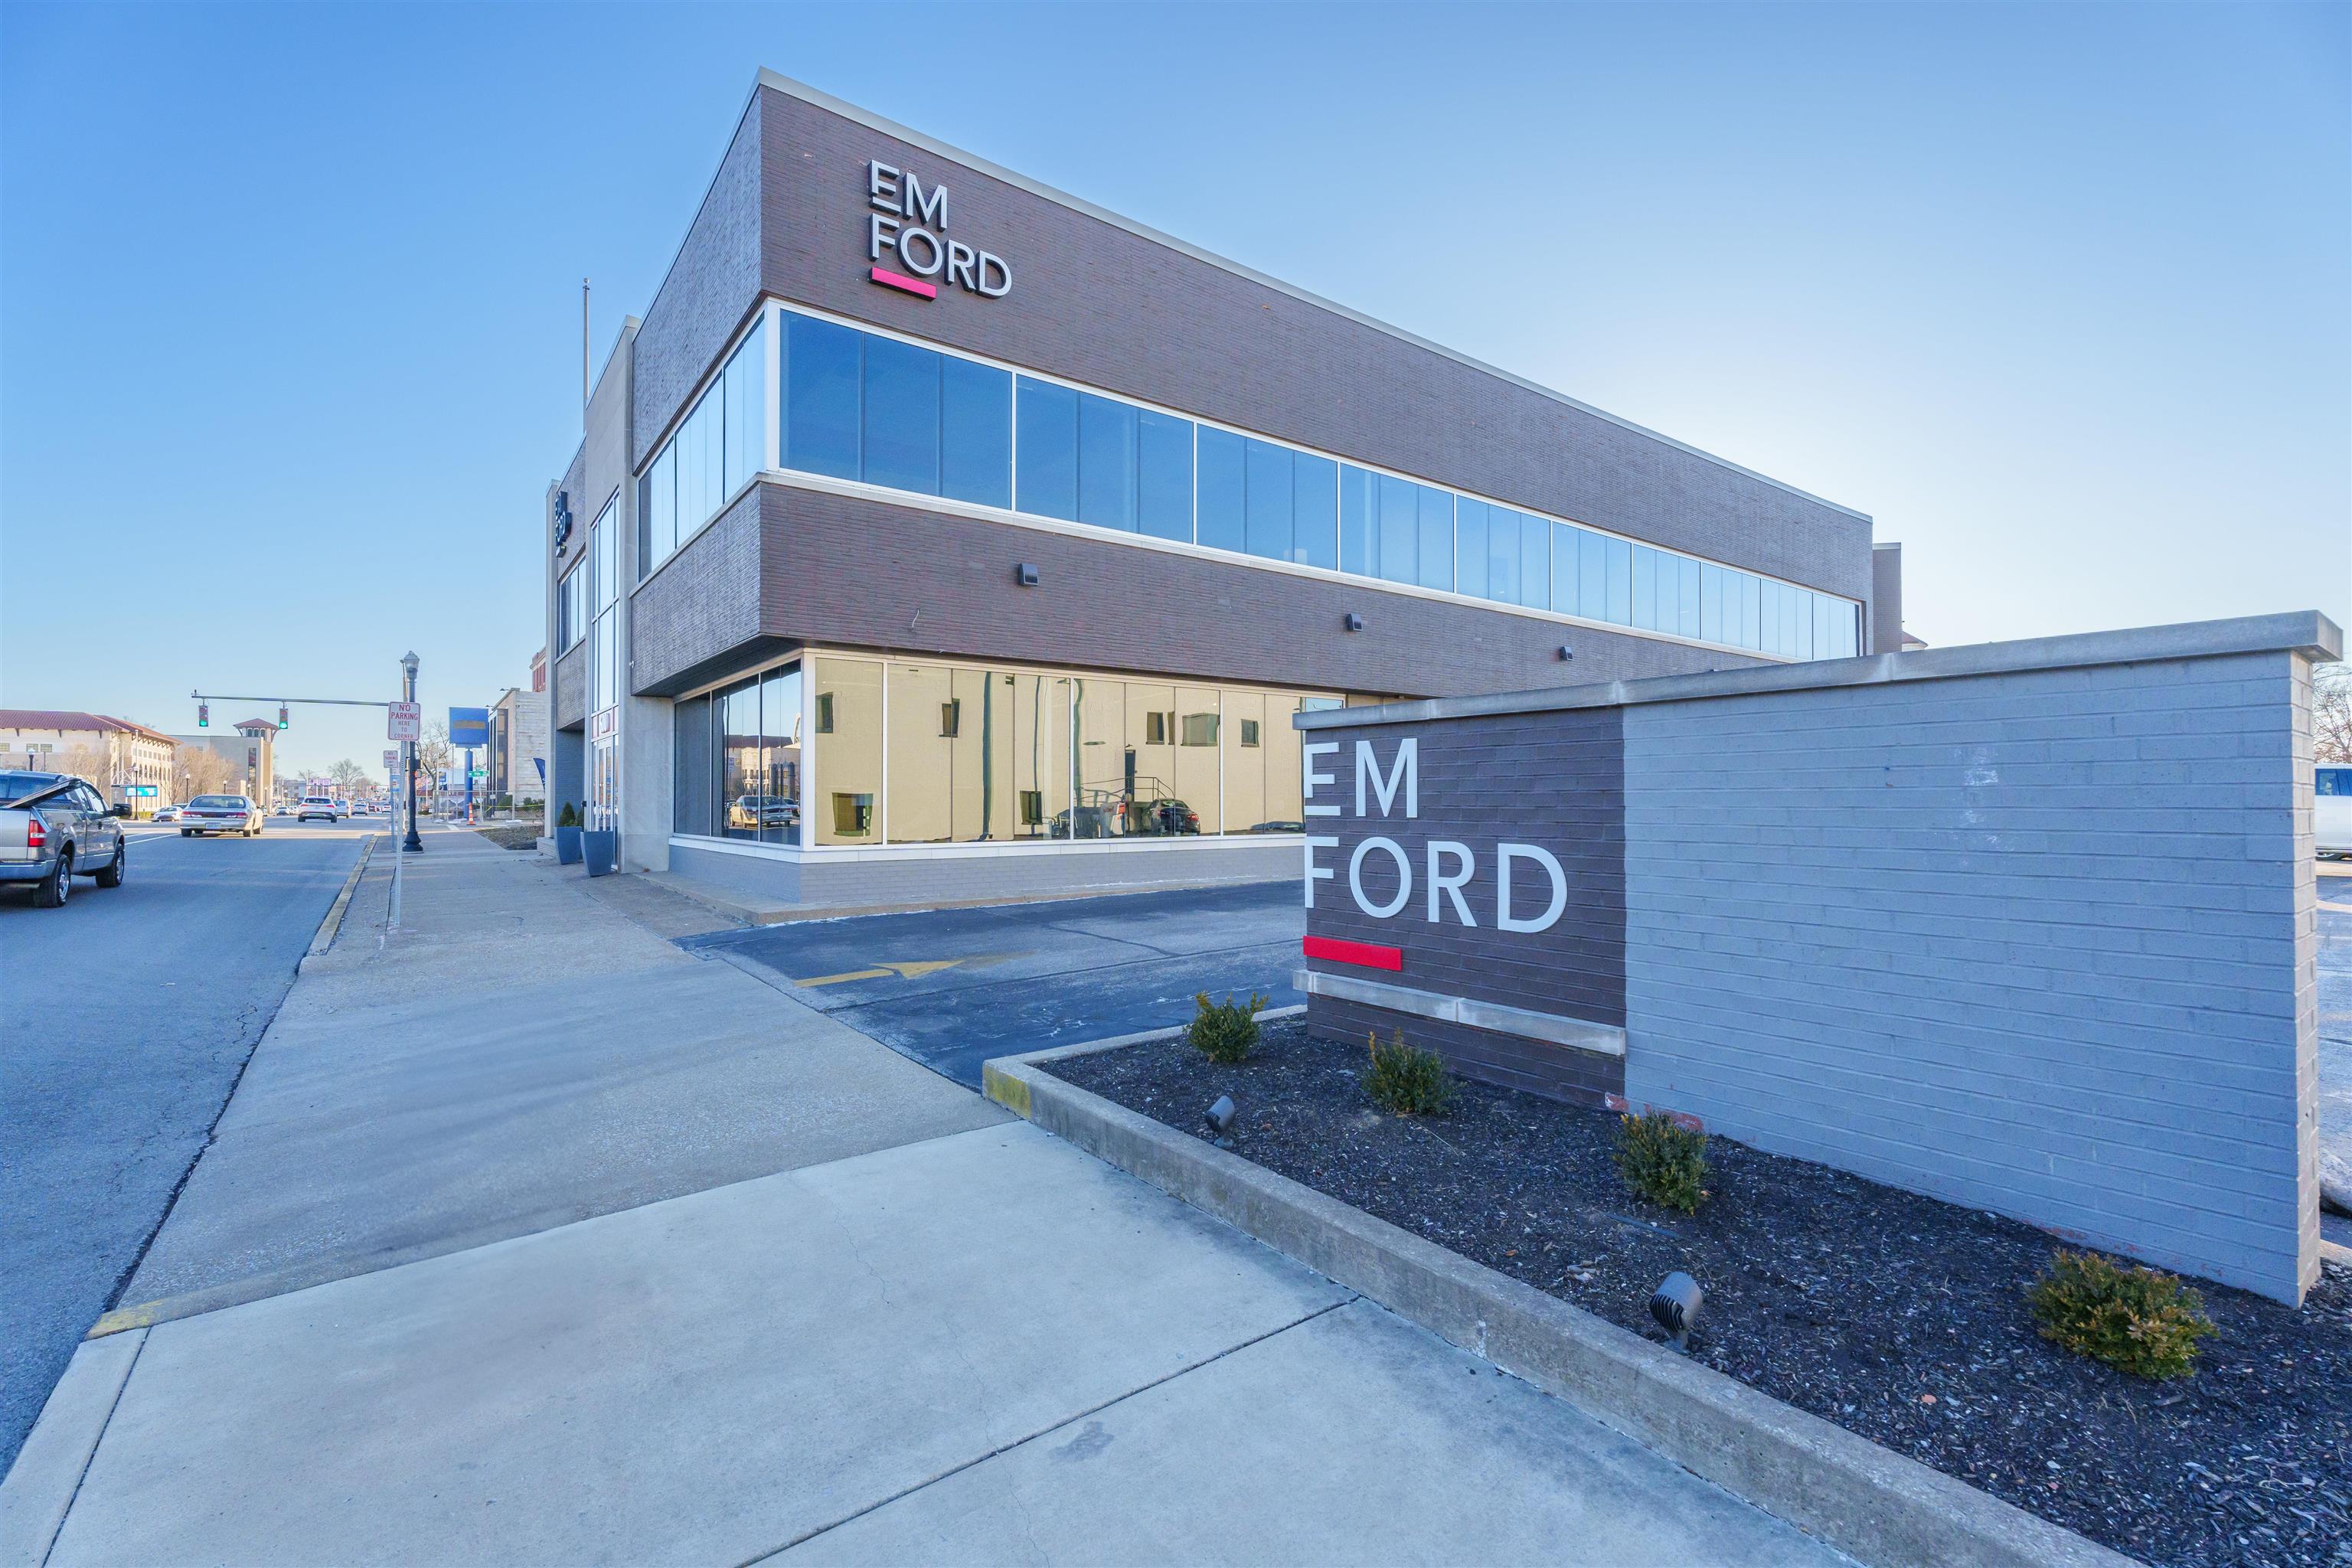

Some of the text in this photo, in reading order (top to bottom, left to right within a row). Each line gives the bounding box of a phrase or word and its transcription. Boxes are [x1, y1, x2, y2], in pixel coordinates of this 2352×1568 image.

[868, 159, 947, 231] EM
[869, 213, 1012, 299] FORD
[390, 712, 418, 720] PARKING
[399, 704, 411, 712] NO
[1304, 737, 1418, 818] EM
[1304, 836, 1568, 933] FORD
